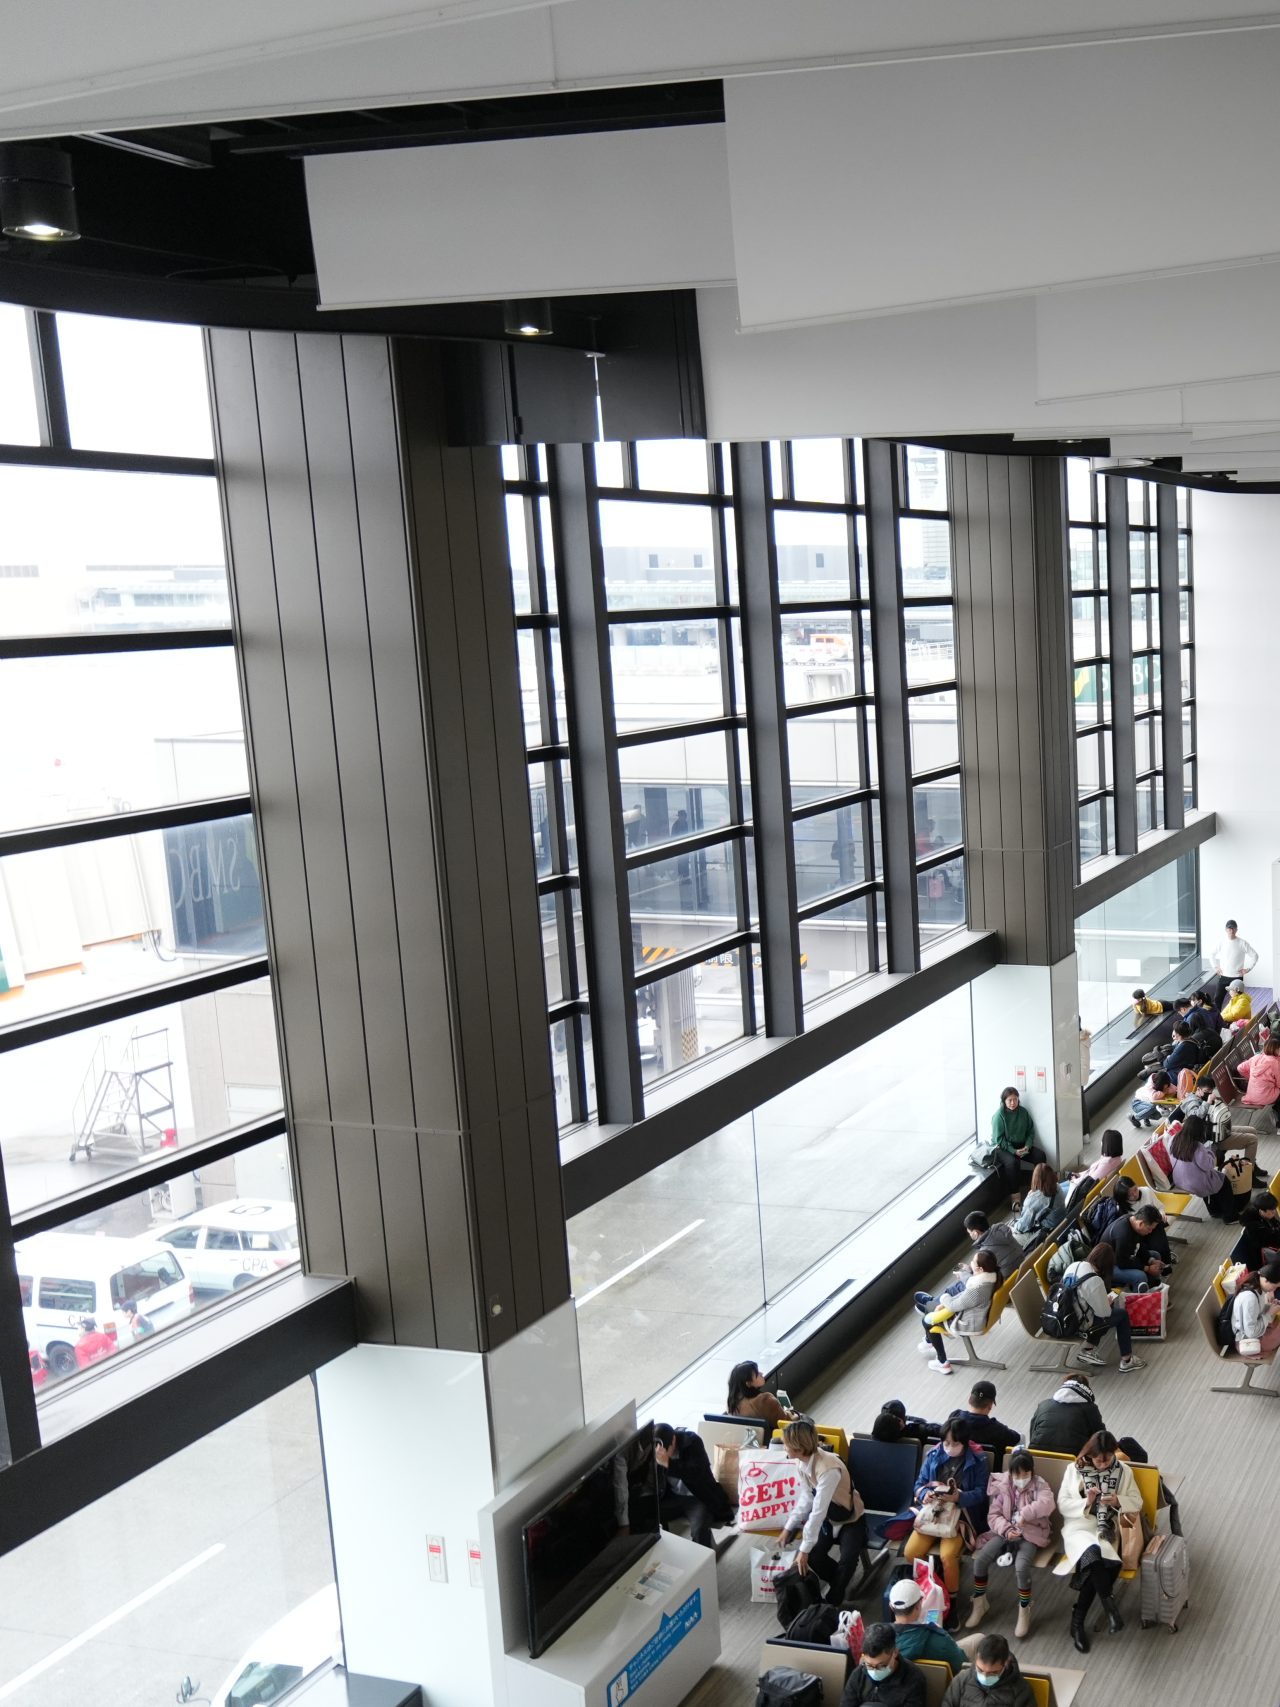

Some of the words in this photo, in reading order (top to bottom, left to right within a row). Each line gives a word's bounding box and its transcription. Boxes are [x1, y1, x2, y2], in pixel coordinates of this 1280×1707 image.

[1101, 661, 1162, 691] SBC
[242, 1257, 270, 1272] CPA
[740, 1476, 796, 1507] GET!
[741, 1499, 796, 1522] HAPPY!
